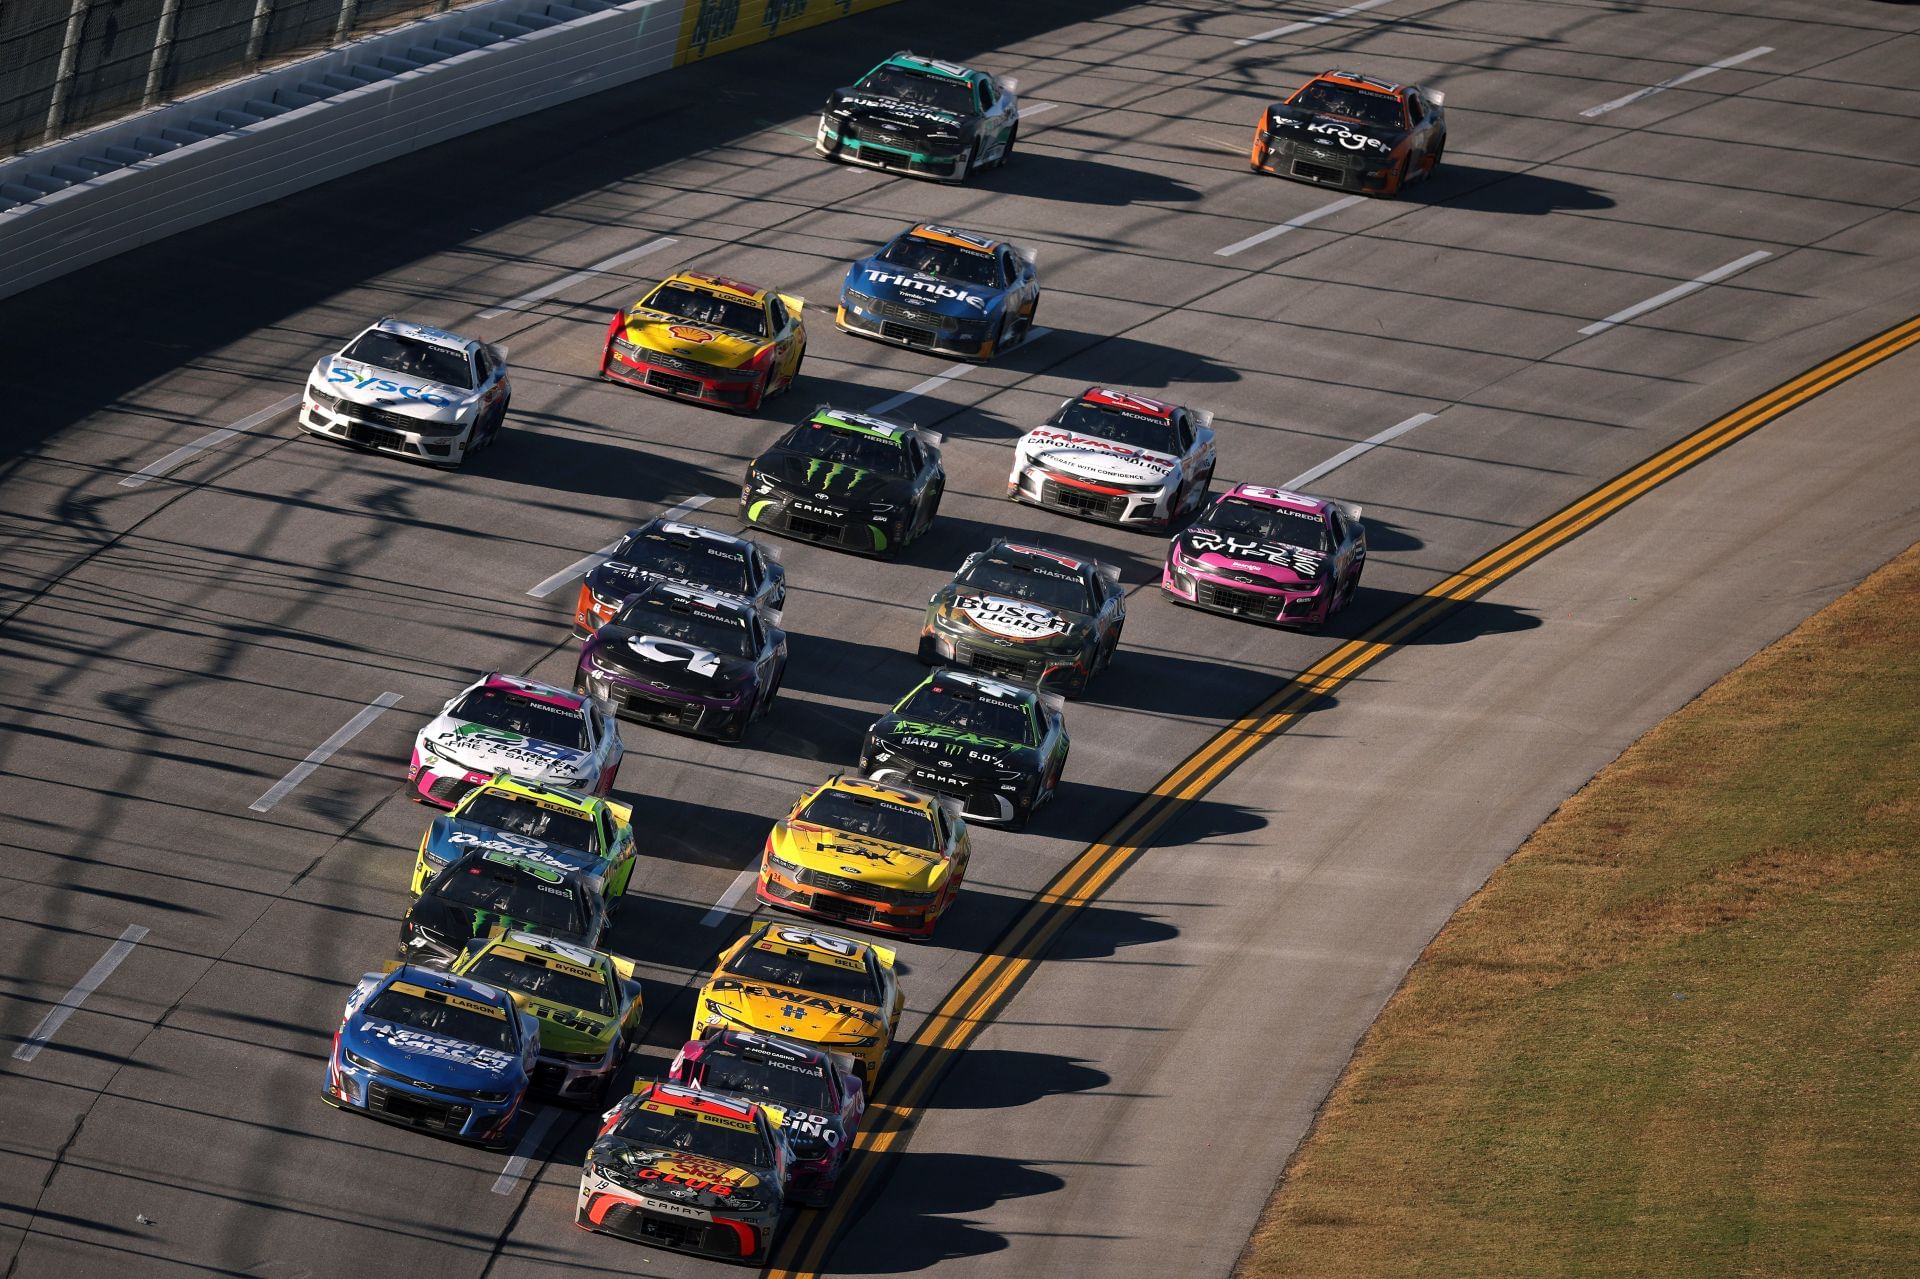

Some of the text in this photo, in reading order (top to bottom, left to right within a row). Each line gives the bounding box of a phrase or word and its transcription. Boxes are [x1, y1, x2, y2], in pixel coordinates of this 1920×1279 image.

[1306, 123, 1391, 154] Kroger
[960, 248, 992, 260] PREECE
[865, 269, 985, 311] Trimble
[898, 291, 937, 304] Trimble.com
[718, 293, 767, 308] LOGANO
[427, 345, 463, 359] CUSTER
[613, 351, 624, 362] 22
[1121, 411, 1169, 427] MCDOWELL
[1032, 430, 1174, 468] RAYMOND
[1028, 438, 1171, 477] CAROLINA HANDLING
[1097, 469, 1147, 481] CONFIDENCE.
[794, 502, 844, 518] CAMRY
[1277, 509, 1320, 524] ALFREDO
[706, 549, 743, 563] BUSCH
[1191, 539, 1319, 576] WIPES
[1033, 568, 1083, 584] CHASTAIN
[593, 603, 602, 614] 8
[673, 597, 693, 605] ally
[692, 610, 737, 626] BOWMAN
[953, 595, 1070, 636] BUSCH
[976, 611, 1041, 633] LIGHT
[592, 669, 604, 680] 48
[530, 702, 589, 721] NEMECHEK
[978, 696, 1020, 712] REDDICK
[447, 740, 481, 751] FIRE
[901, 736, 1005, 769] HARD 6.0%
[875, 751, 892, 763] 45
[916, 770, 968, 787] CAMRY
[545, 804, 587, 820] BLANEY
[879, 802, 929, 819] GILLILAND
[816, 842, 896, 866] PEAK
[537, 884, 572, 898] GIBBS
[555, 963, 594, 979] BYRON
[834, 958, 860, 969] BELL
[452, 999, 496, 1015] LARSON
[768, 1060, 823, 1078] HOCEVAR
[703, 1114, 752, 1131] BRISCOE
[594, 1180, 610, 1190] 19
[637, 1168, 734, 1197] CLUB
[646, 1200, 705, 1216] CAMRY
